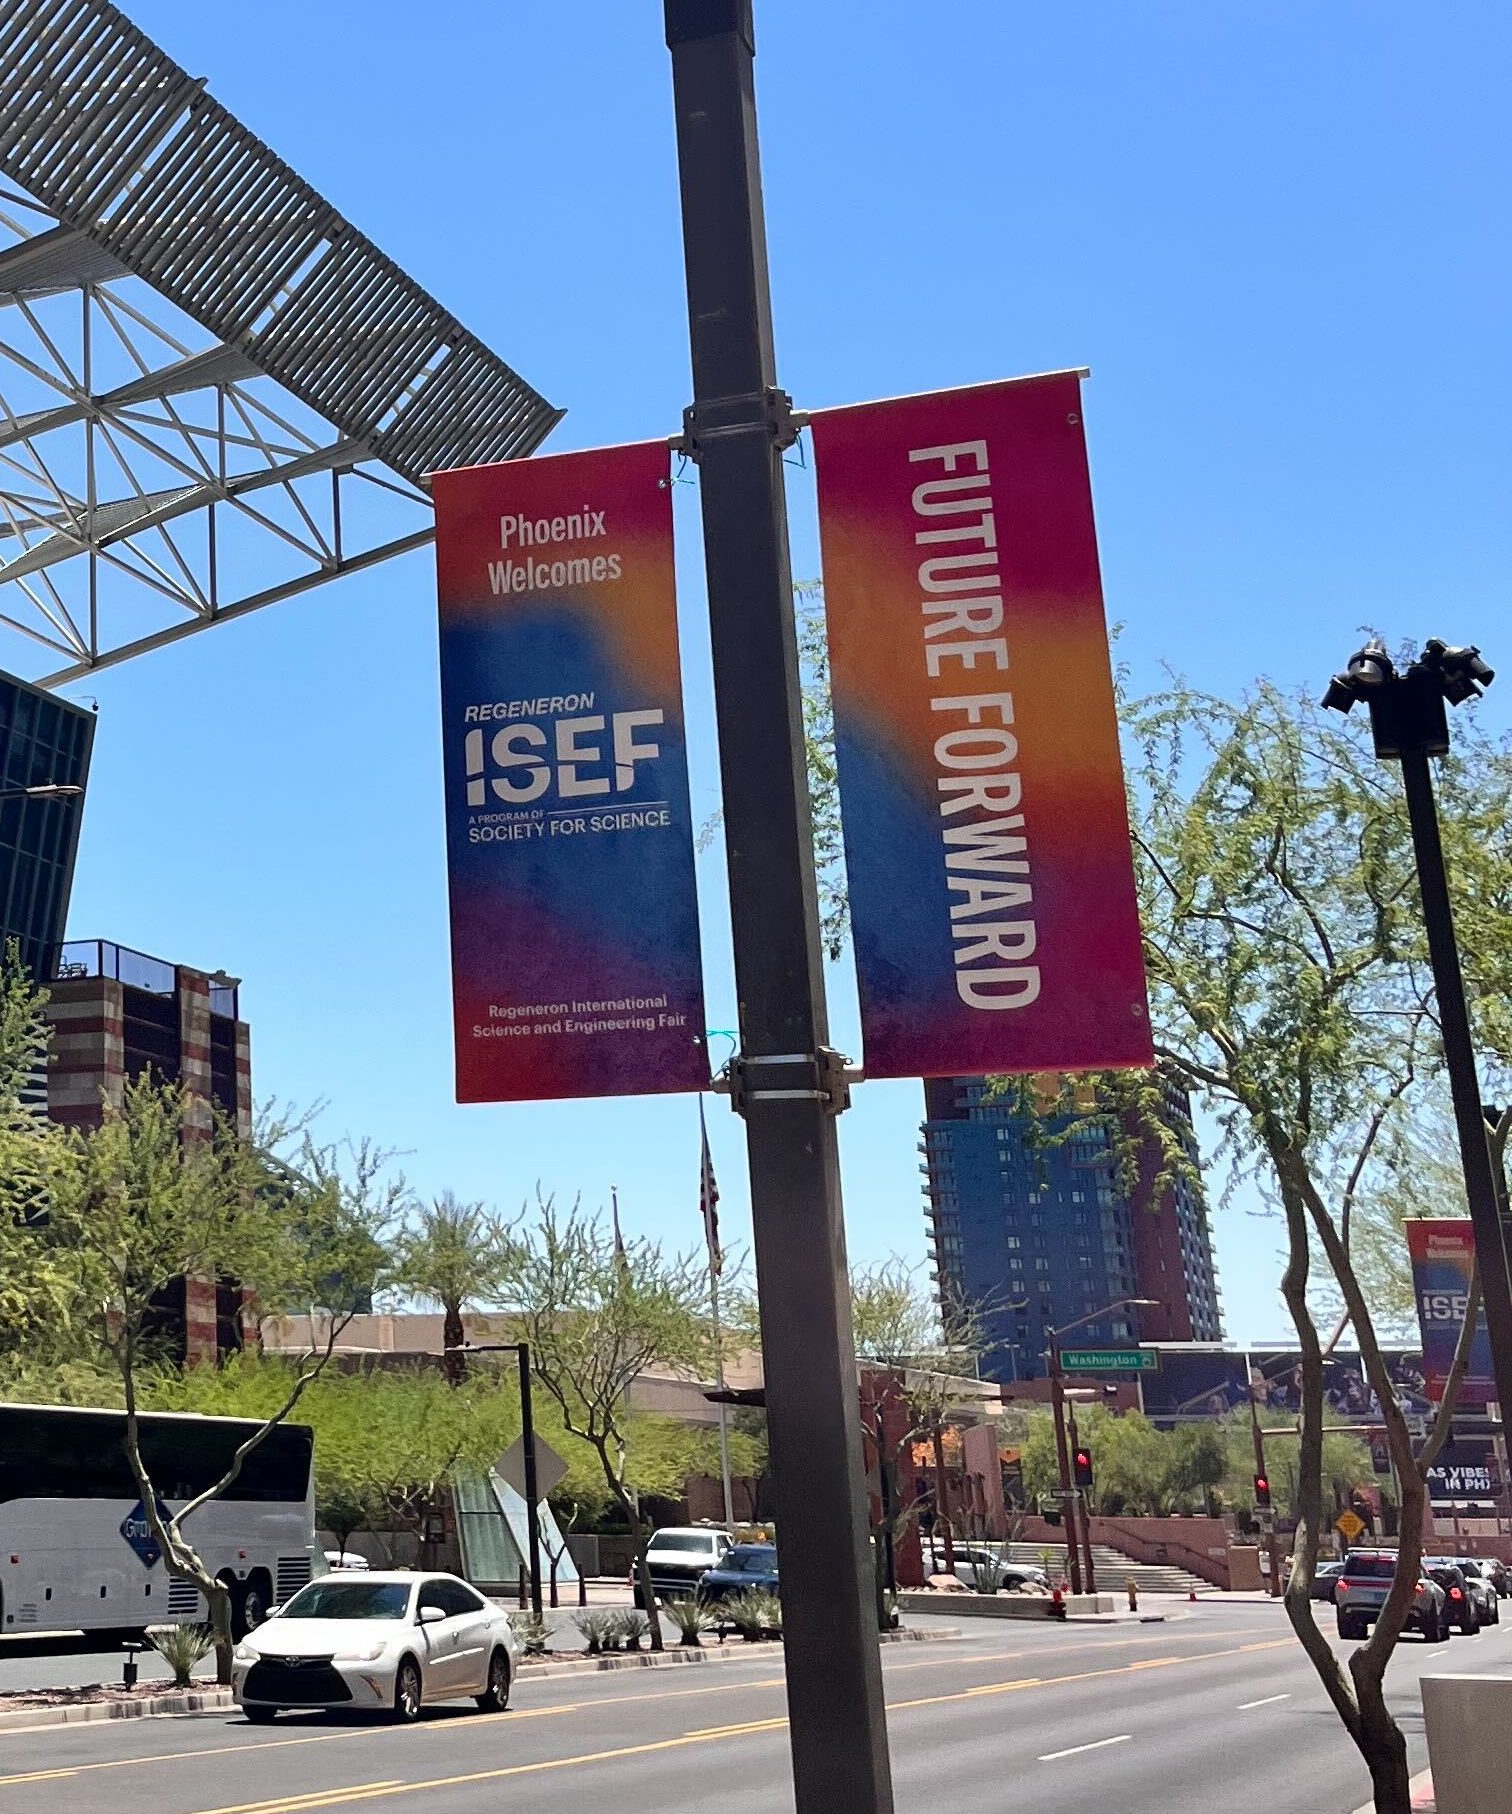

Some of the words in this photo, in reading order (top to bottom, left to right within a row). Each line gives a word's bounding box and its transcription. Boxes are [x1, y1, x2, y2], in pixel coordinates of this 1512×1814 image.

[500, 504, 607, 549] Phoenix
[908, 439, 1009, 678] FUTURE
[488, 553, 622, 595] Welcomes
[464, 692, 595, 722] REGENERON
[464, 709, 664, 806] ISEF
[467, 816, 476, 825] A
[477, 811, 529, 824] PROGRAM
[531, 810, 545, 819] OF
[468, 822, 546, 843] SOCIETY
[550, 818, 586, 836] FOR
[590, 811, 672, 832] SCIENCE
[930, 692, 1041, 1010] FORWARD
[488, 1002, 569, 1019] Regeneron
[572, 994, 668, 1013] International
[472, 1024, 531, 1038] Science
[534, 1021, 562, 1034] and
[565, 1015, 656, 1035] Engineering
[658, 1012, 688, 1028] Fair
[1422, 1295, 1484, 1320] ISE
[1068, 1354, 1138, 1368] Washington
[1445, 1478, 1462, 1490] IN
